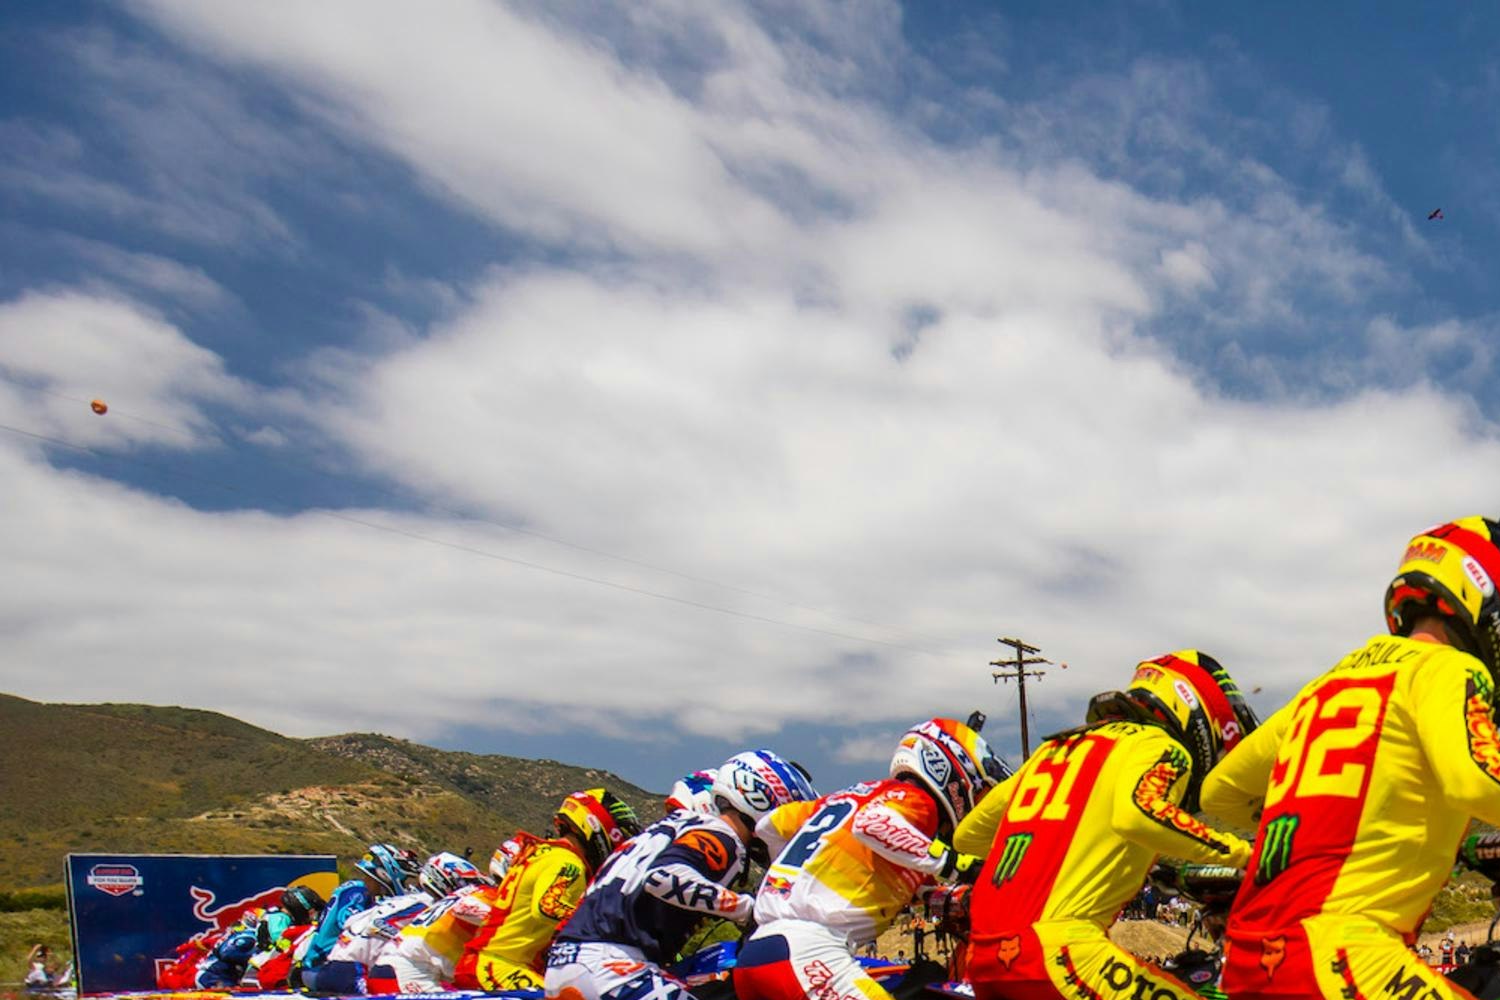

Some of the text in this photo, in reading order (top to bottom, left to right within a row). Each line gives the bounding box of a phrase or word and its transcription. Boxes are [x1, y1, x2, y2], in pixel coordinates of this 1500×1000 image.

[1465, 561, 1489, 590] BELL
[1007, 737, 1096, 823] 61
[1264, 687, 1383, 809] 92
